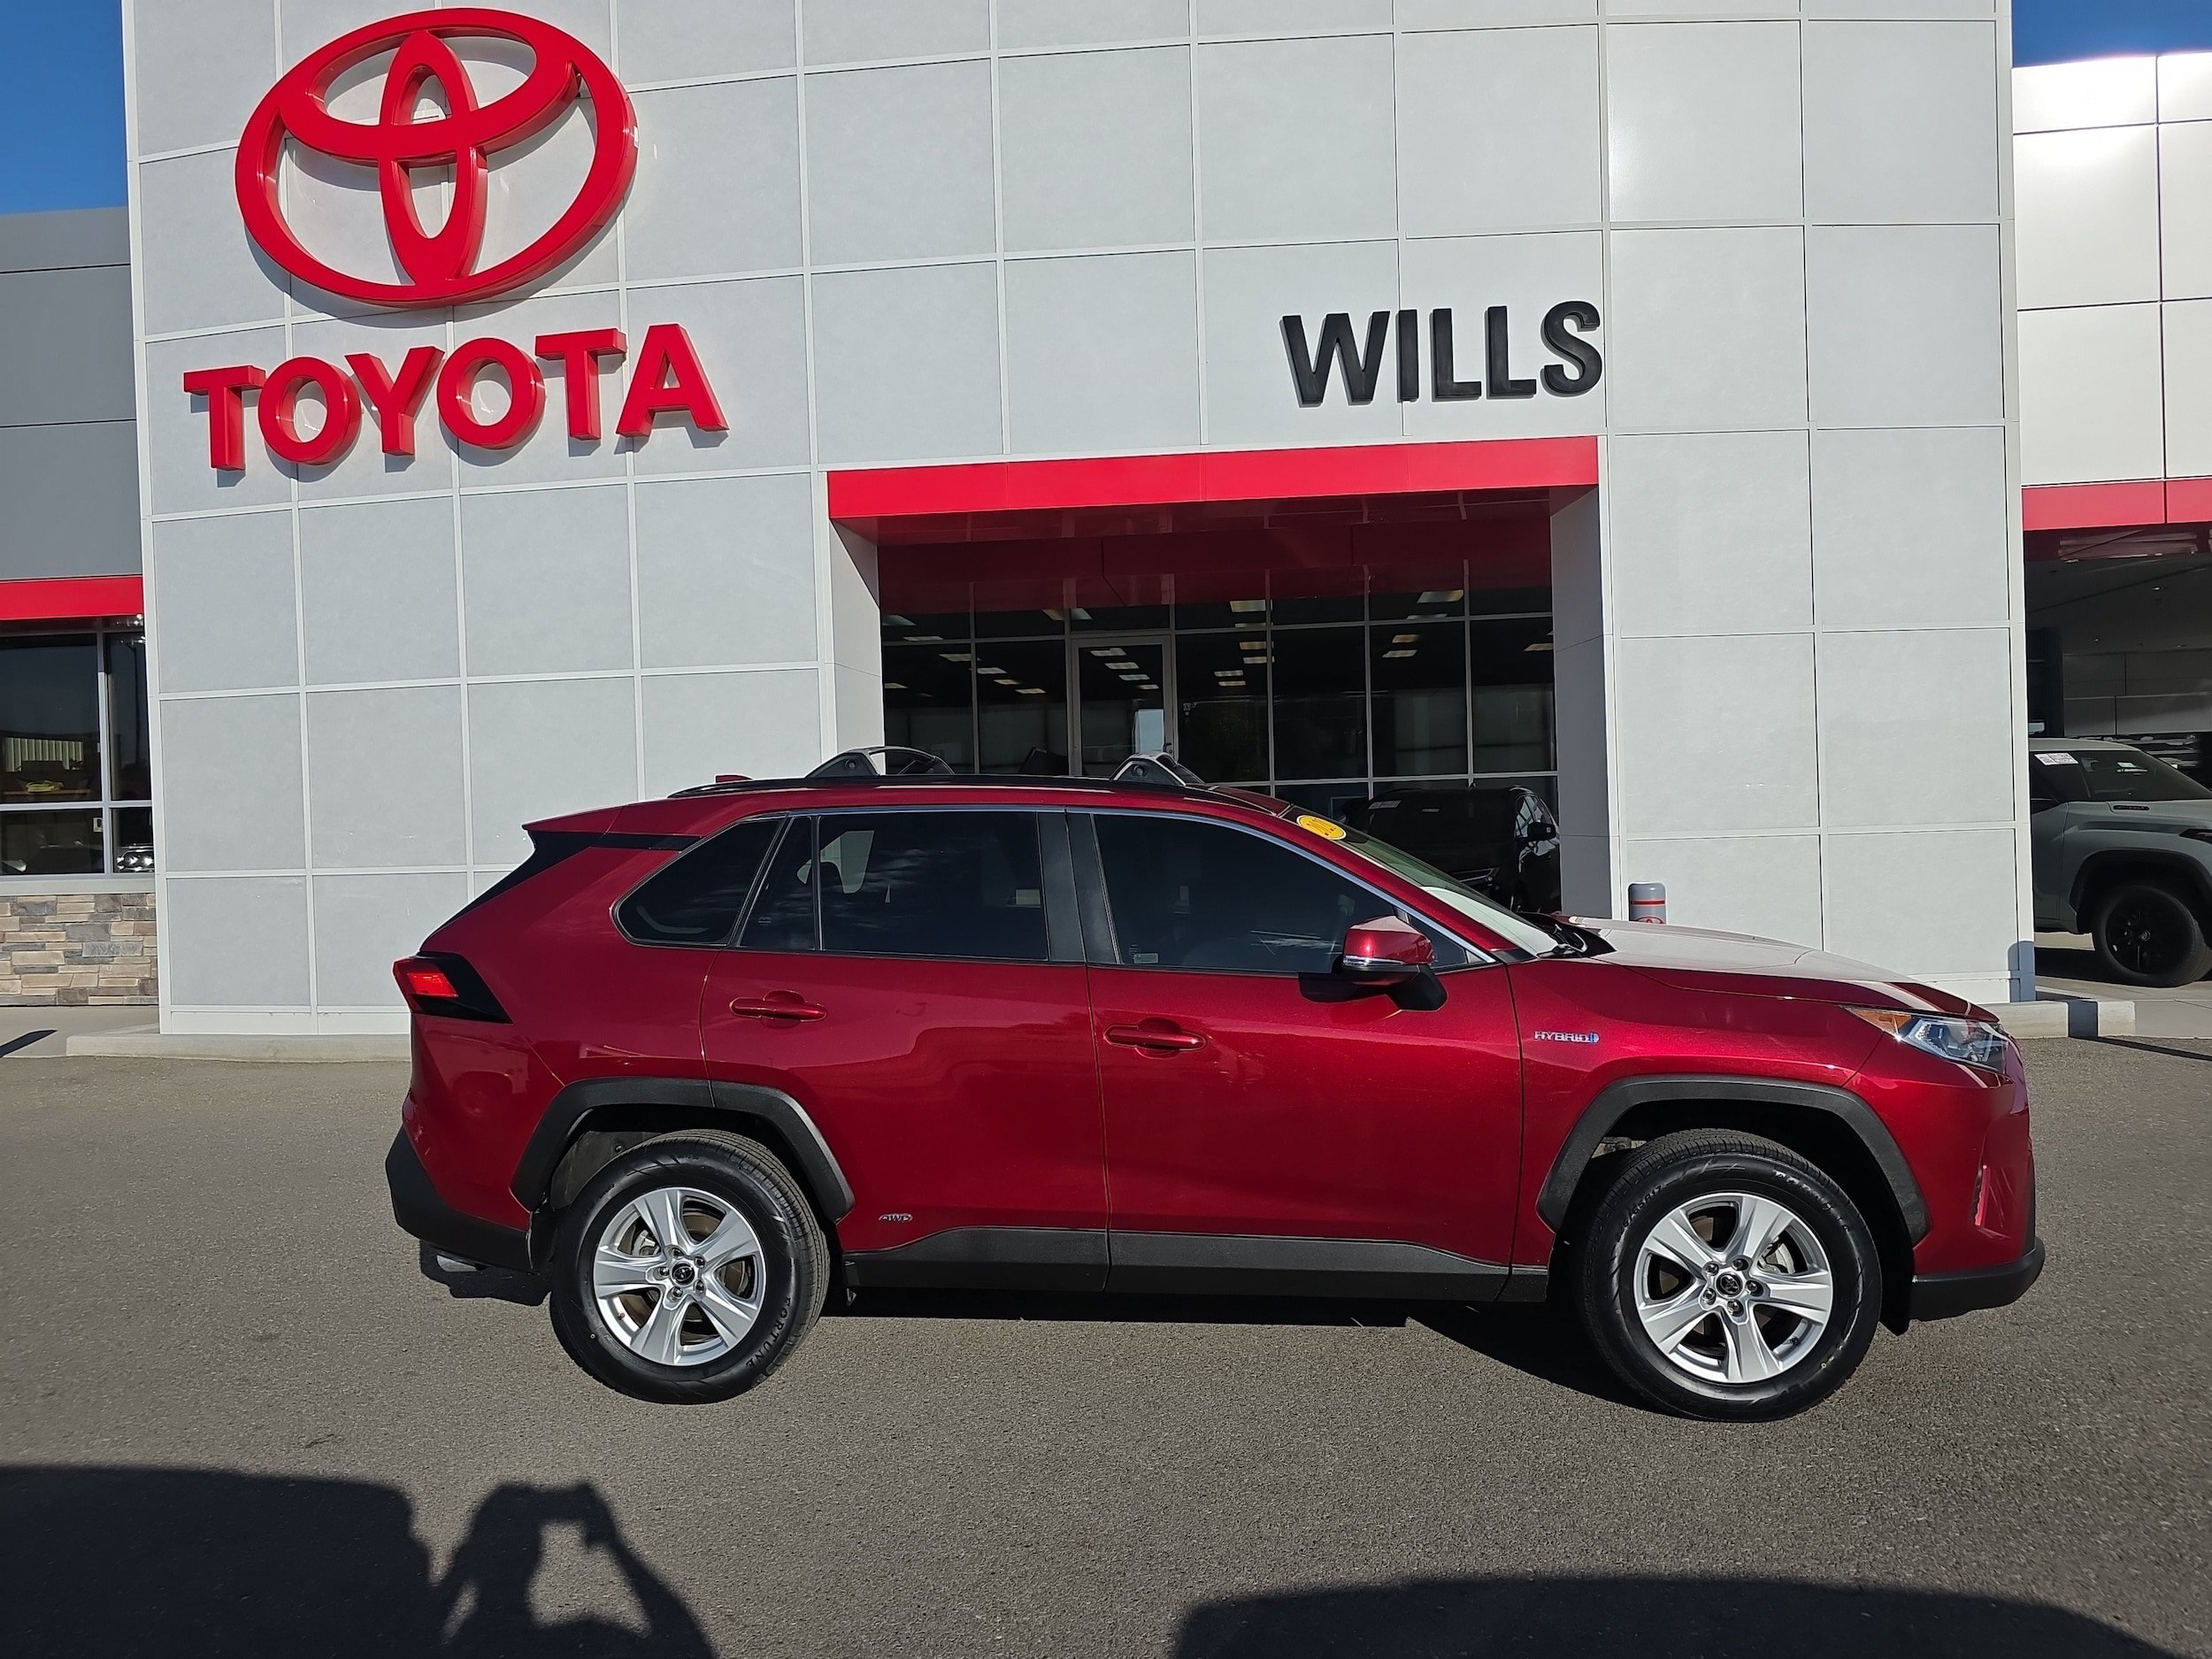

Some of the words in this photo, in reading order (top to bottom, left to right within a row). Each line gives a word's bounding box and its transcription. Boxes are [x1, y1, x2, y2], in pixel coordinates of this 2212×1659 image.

[183, 323, 730, 472] TOYOTA
[1279, 300, 1604, 408] WILLS
[1533, 1030, 1592, 1043] HYBRID
[746, 1297, 791, 1368] FORTUNE
